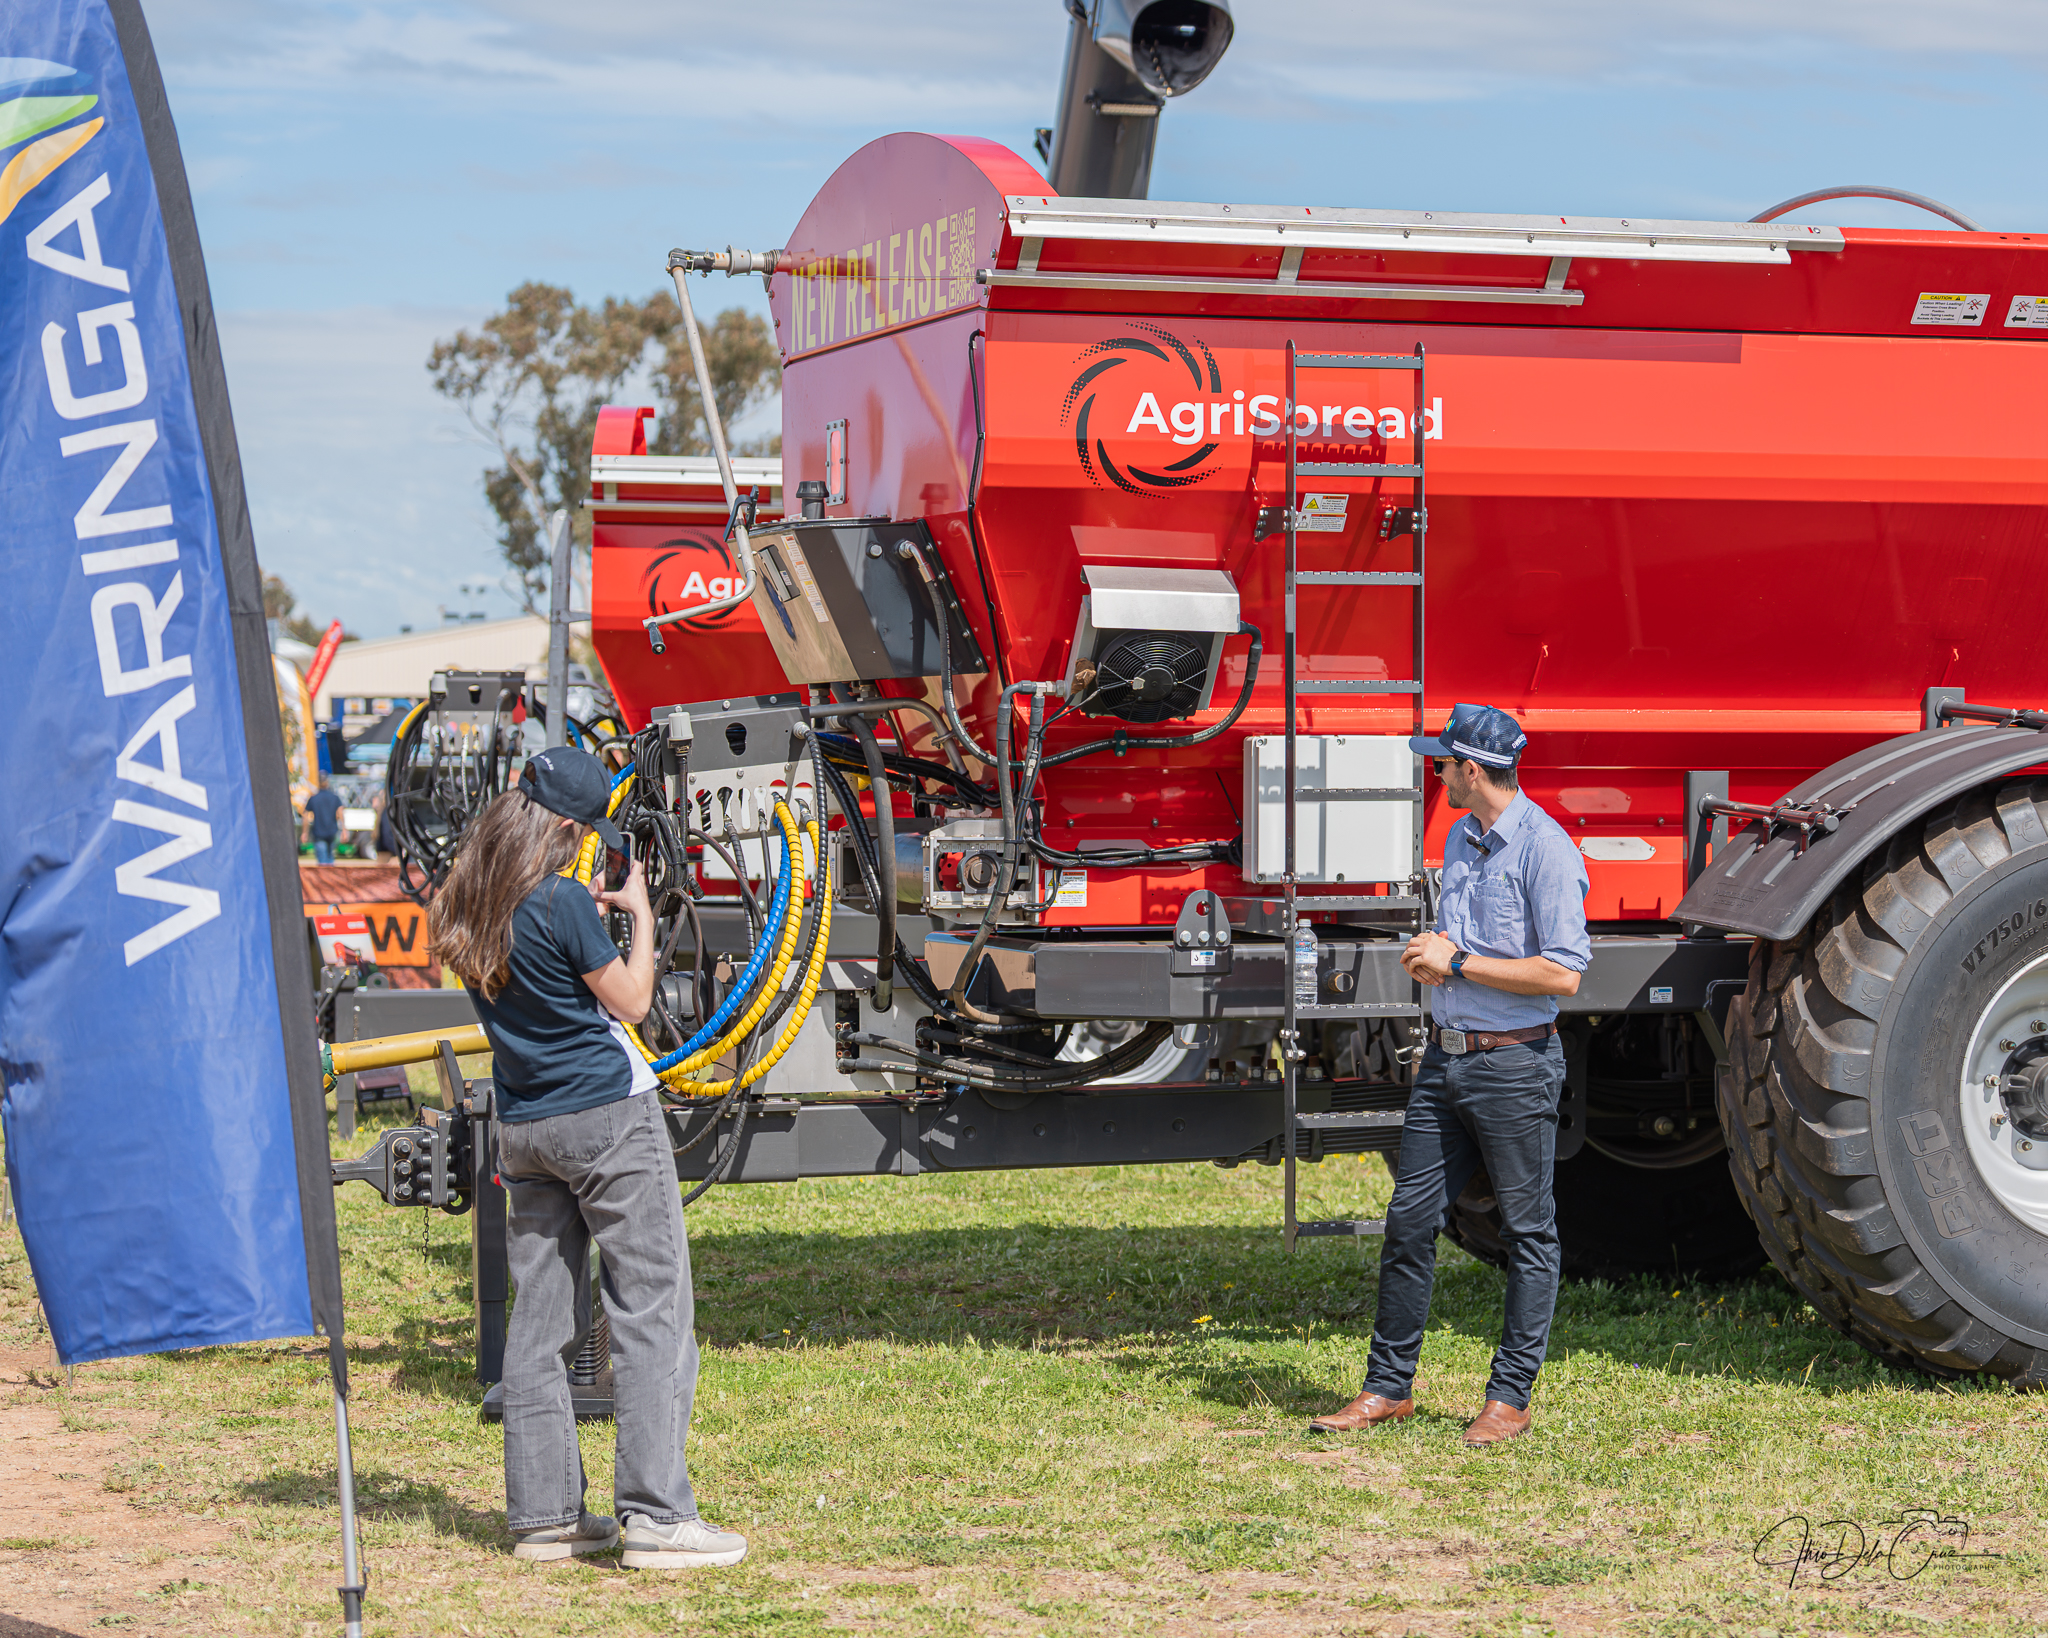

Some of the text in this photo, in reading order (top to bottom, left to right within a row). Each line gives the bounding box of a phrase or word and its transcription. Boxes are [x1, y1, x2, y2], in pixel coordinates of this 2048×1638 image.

[792, 216, 948, 353] NEW RELEASE
[1126, 389, 1443, 445] AgriSpread
[25, 172, 221, 967] WARINGA
[2013, 926, 2040, 947] STEEL
[1906, 1117, 1977, 1237] BKT
